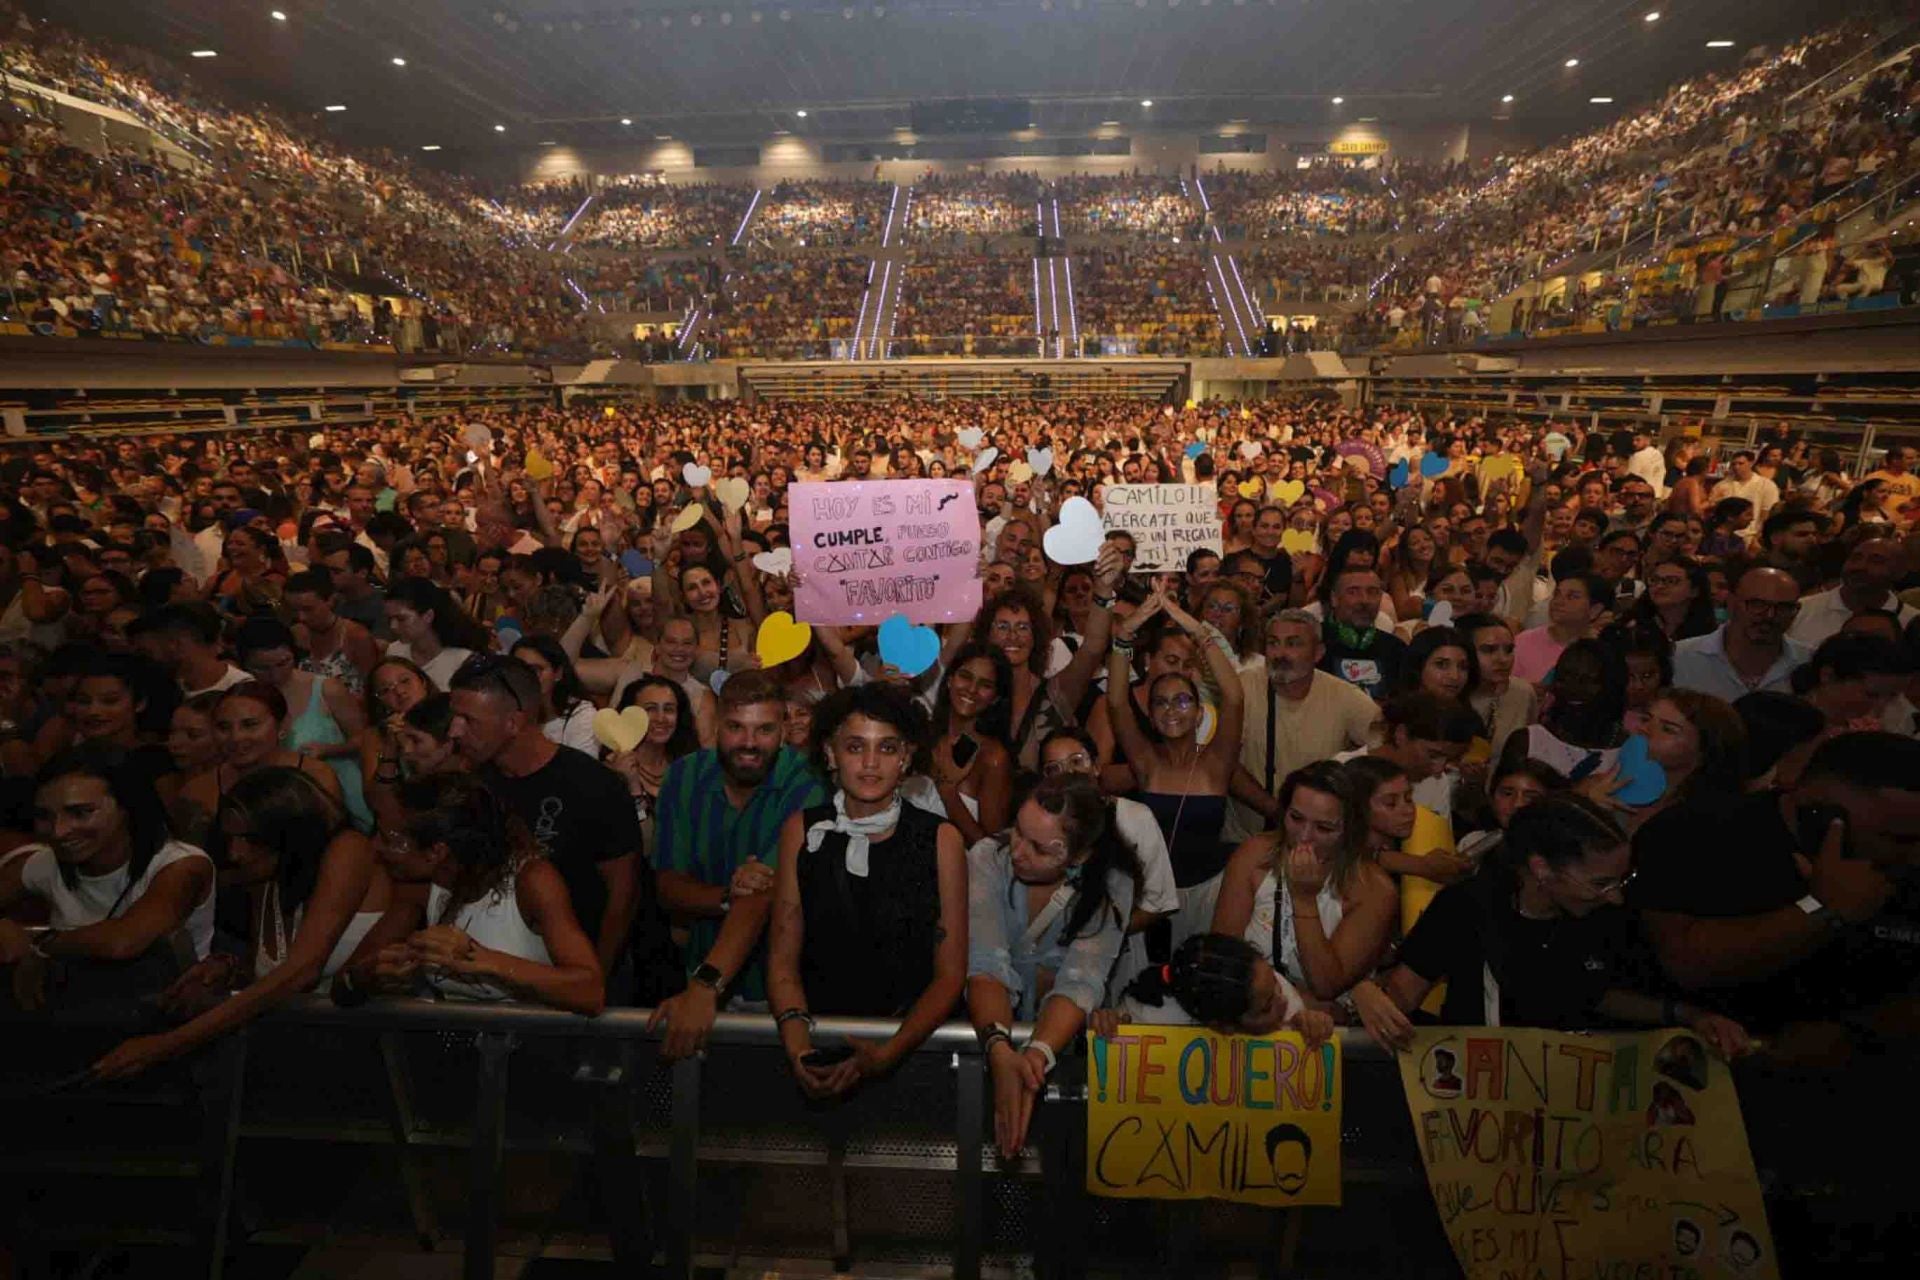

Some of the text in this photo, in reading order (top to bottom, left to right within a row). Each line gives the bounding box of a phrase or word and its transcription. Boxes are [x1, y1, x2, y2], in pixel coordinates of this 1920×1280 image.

[813, 497, 859, 520] HOY
[872, 493, 896, 516] ES
[1186, 511, 1212, 525] QUE
[1150, 529, 1167, 542] UN
[814, 546, 894, 573] CANTAR
[1178, 1036, 1336, 1112] QUIERO!
